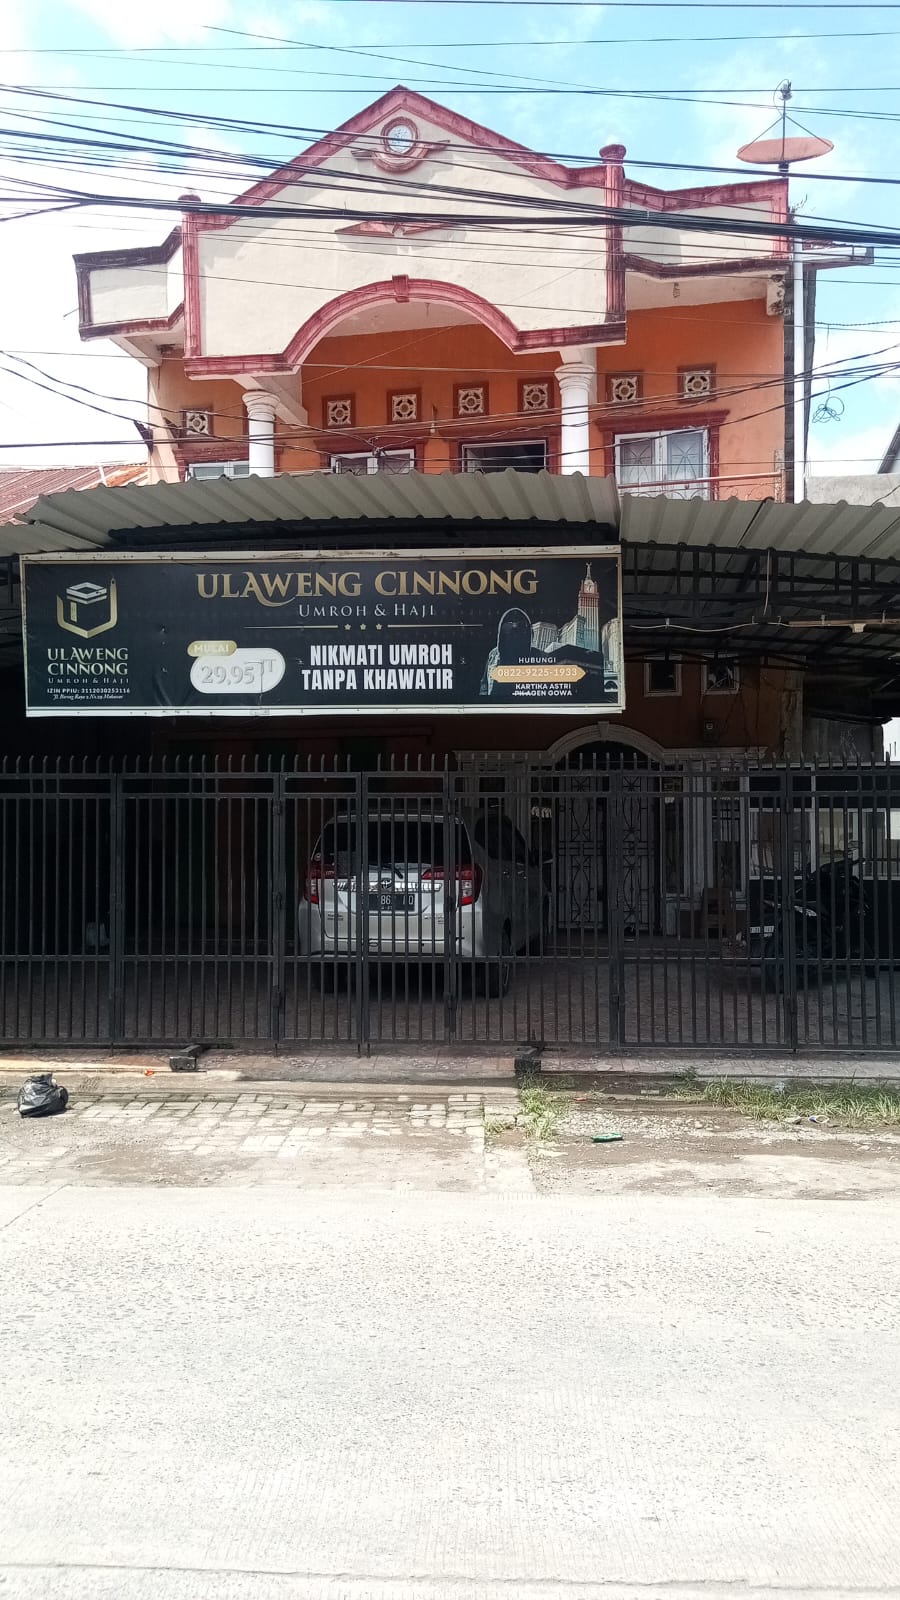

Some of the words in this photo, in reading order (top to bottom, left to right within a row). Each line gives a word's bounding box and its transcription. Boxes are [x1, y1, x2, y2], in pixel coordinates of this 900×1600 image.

[196, 571, 363, 607] ULAWENG
[374, 569, 539, 596] CINNONG
[374, 603, 386, 617] &
[47, 646, 129, 665] ULAWENG
[310, 645, 384, 666] NIKMATI
[389, 644, 453, 665] UMROH
[47, 662, 128, 676] CINNONG
[497, 667, 577, 677] 0822-9225-1933
[302, 669, 358, 691] TANPA
[364, 668, 453, 690] KHAWATIR
